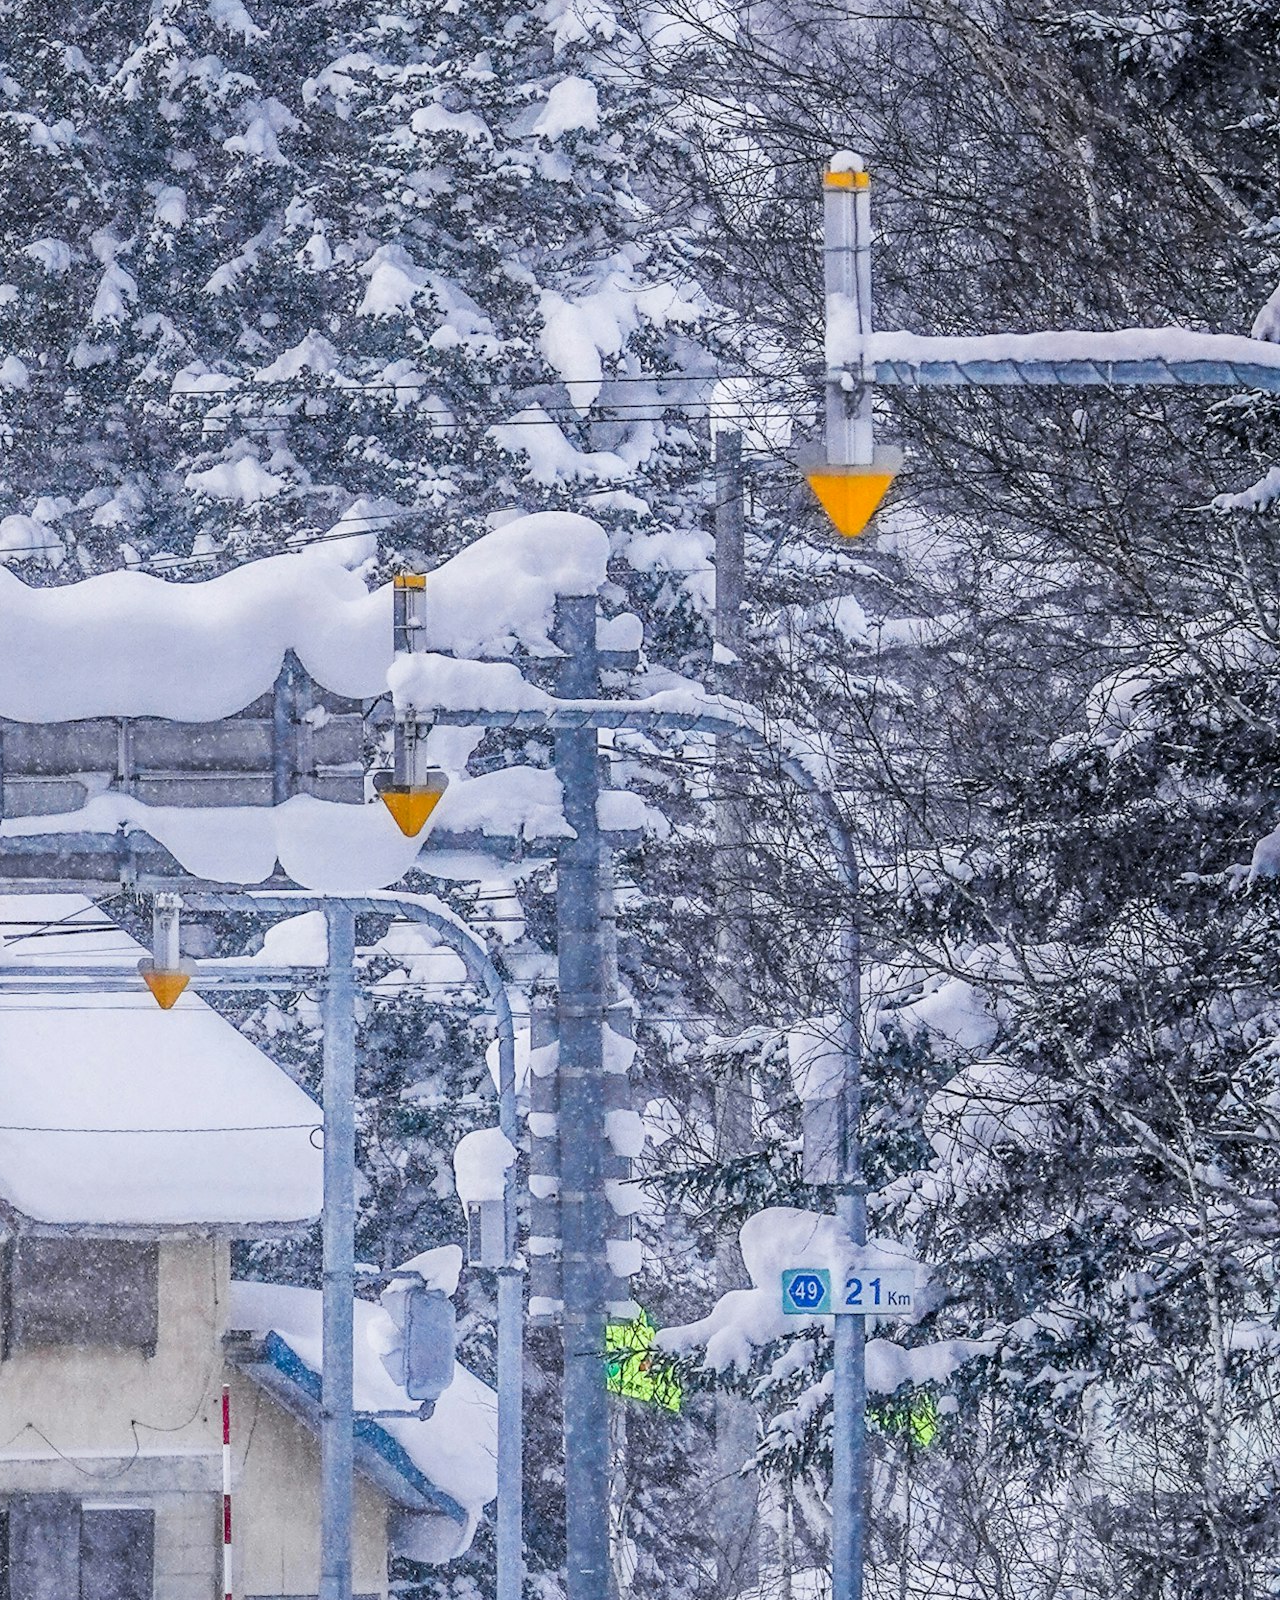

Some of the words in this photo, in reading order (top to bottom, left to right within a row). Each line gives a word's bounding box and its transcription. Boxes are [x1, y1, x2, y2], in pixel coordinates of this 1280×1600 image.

[795, 1281, 818, 1300] 49
[845, 1277, 882, 1306] 21
[888, 1291, 911, 1306] Km
